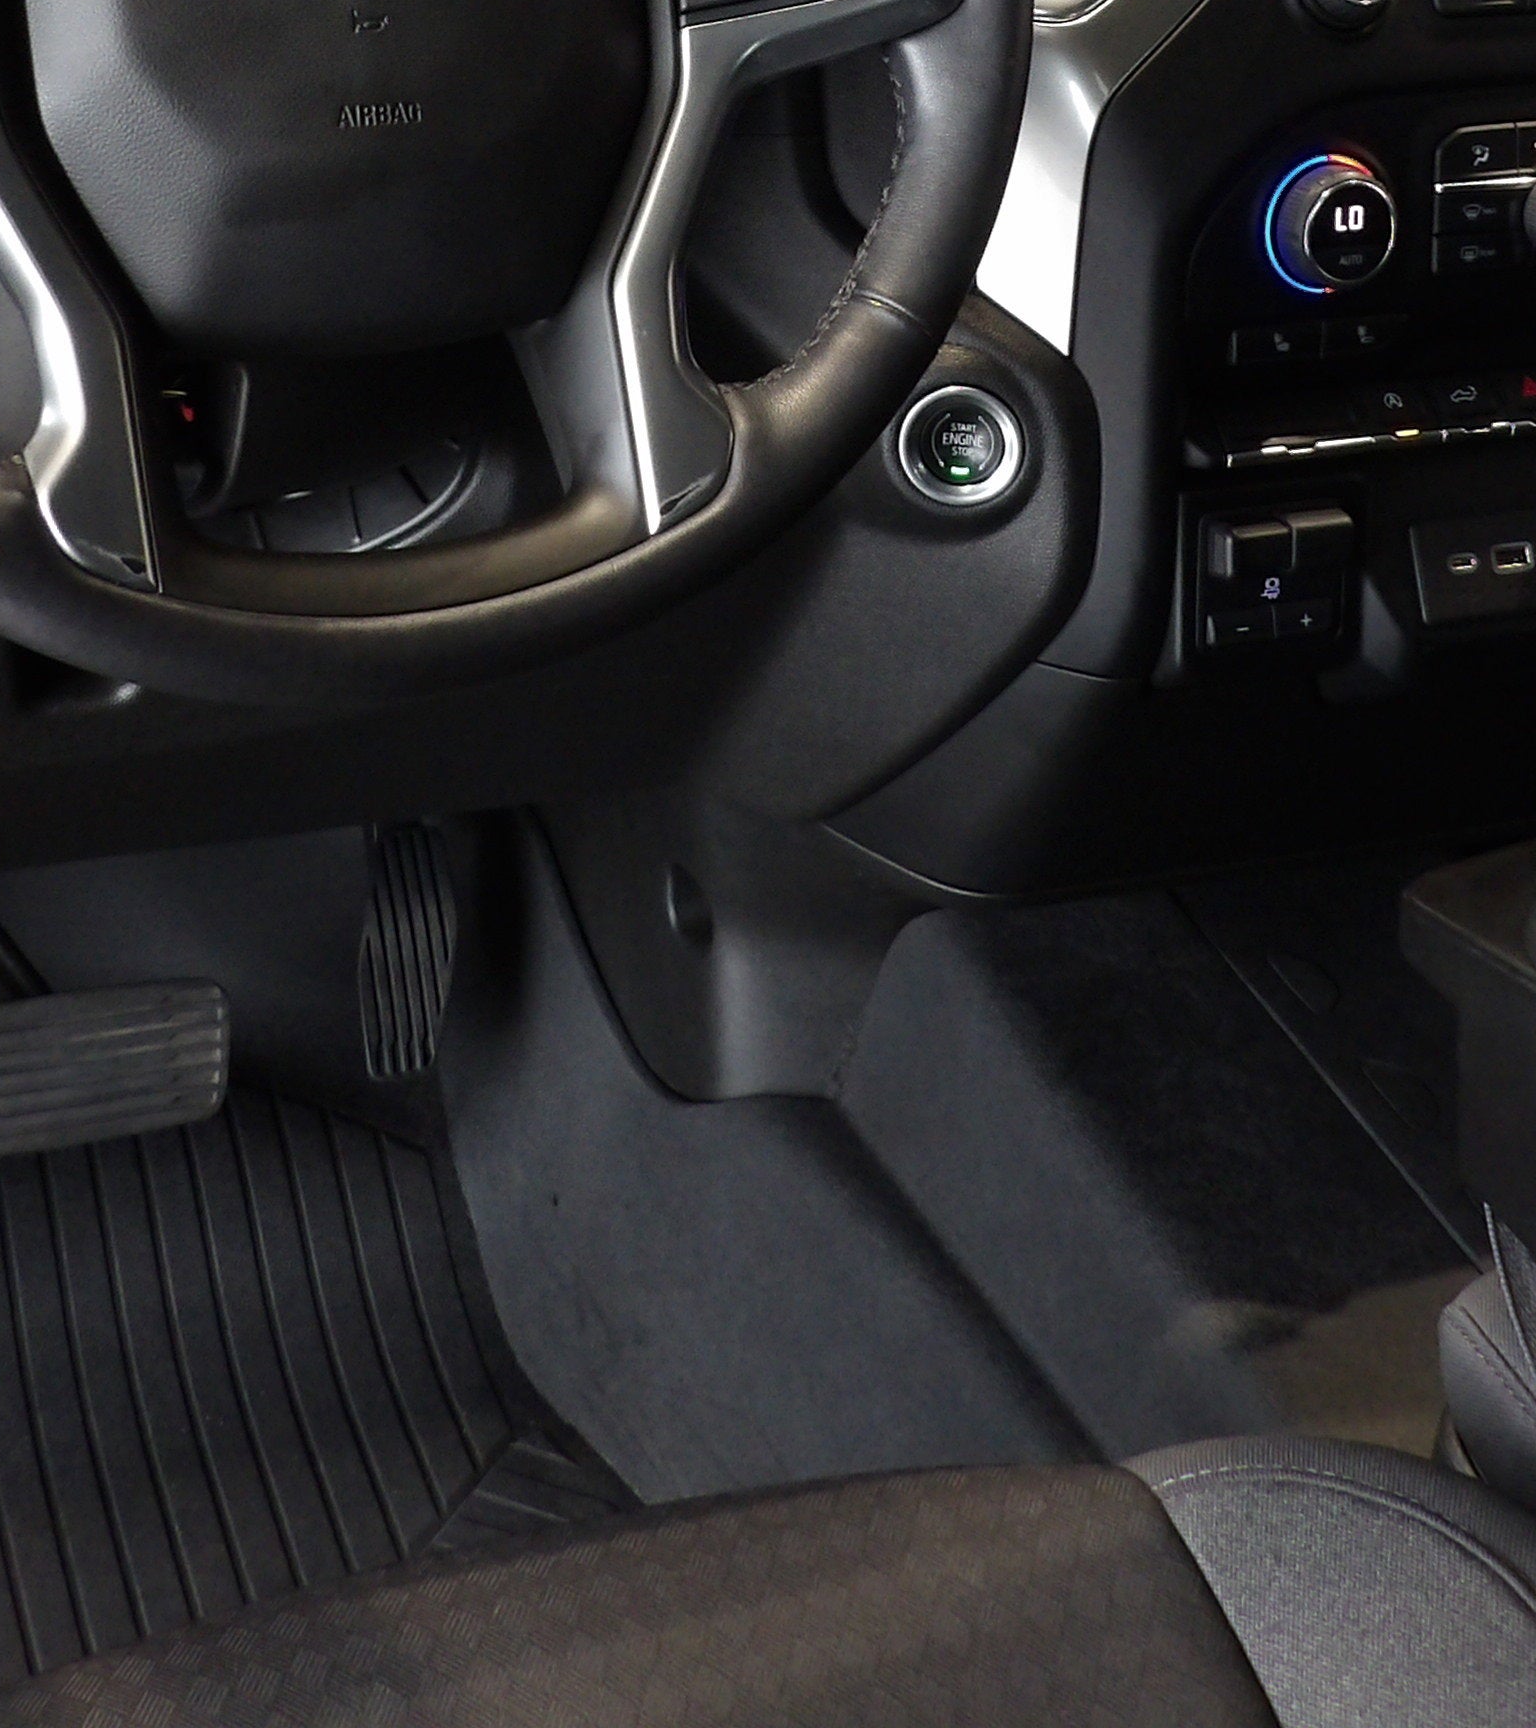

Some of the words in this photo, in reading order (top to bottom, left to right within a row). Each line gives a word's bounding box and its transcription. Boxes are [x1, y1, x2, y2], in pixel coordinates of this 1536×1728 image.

[1334, 204, 1364, 232] LO
[950, 423, 977, 433] START
[942, 432, 984, 448] ENGINE
[951, 446, 975, 456] STOP
